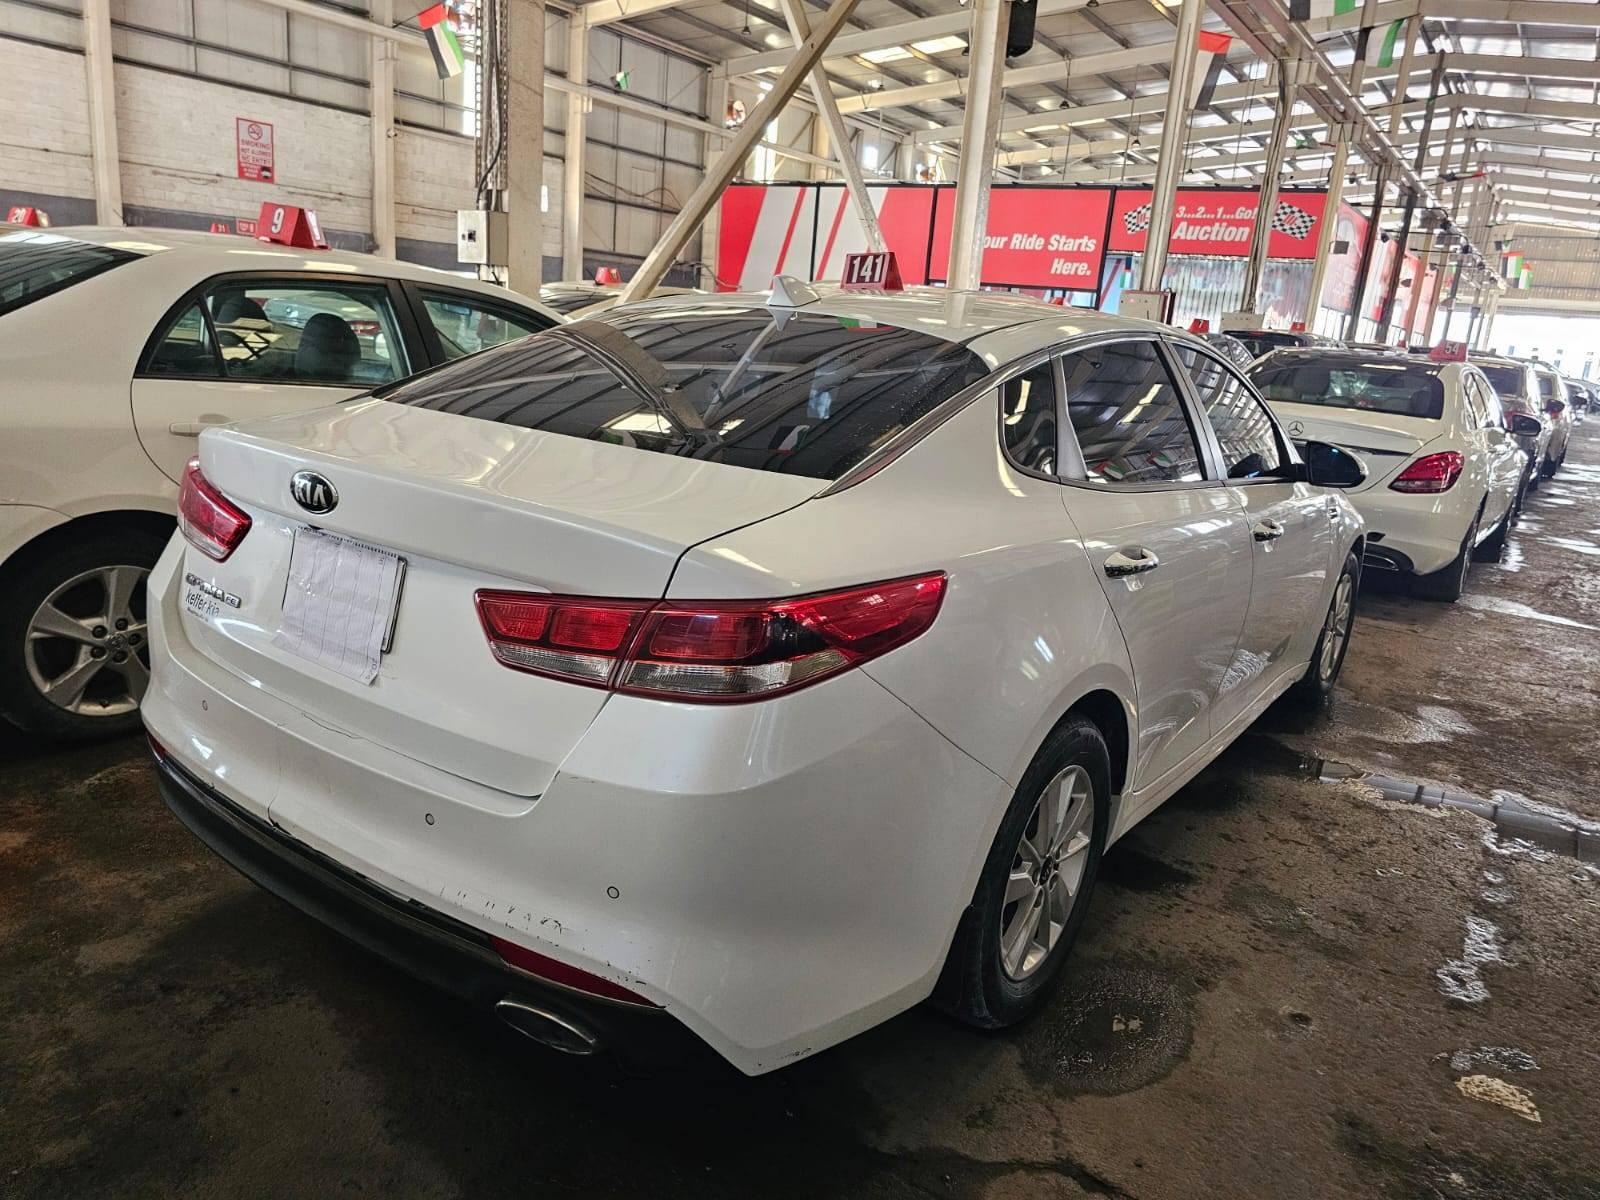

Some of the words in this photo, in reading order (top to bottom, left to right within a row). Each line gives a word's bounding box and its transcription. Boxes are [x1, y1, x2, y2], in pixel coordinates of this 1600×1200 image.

[271, 207, 285, 234] 9
[1172, 221, 1250, 242] Auction
[984, 235, 1008, 249] our
[1009, 233, 1045, 250] Ride
[1047, 234, 1097, 252] Starts
[851, 254, 884, 283] 141
[1050, 258, 1092, 276] Here.
[1445, 341, 1460, 355] 54
[294, 478, 328, 508] KIA
